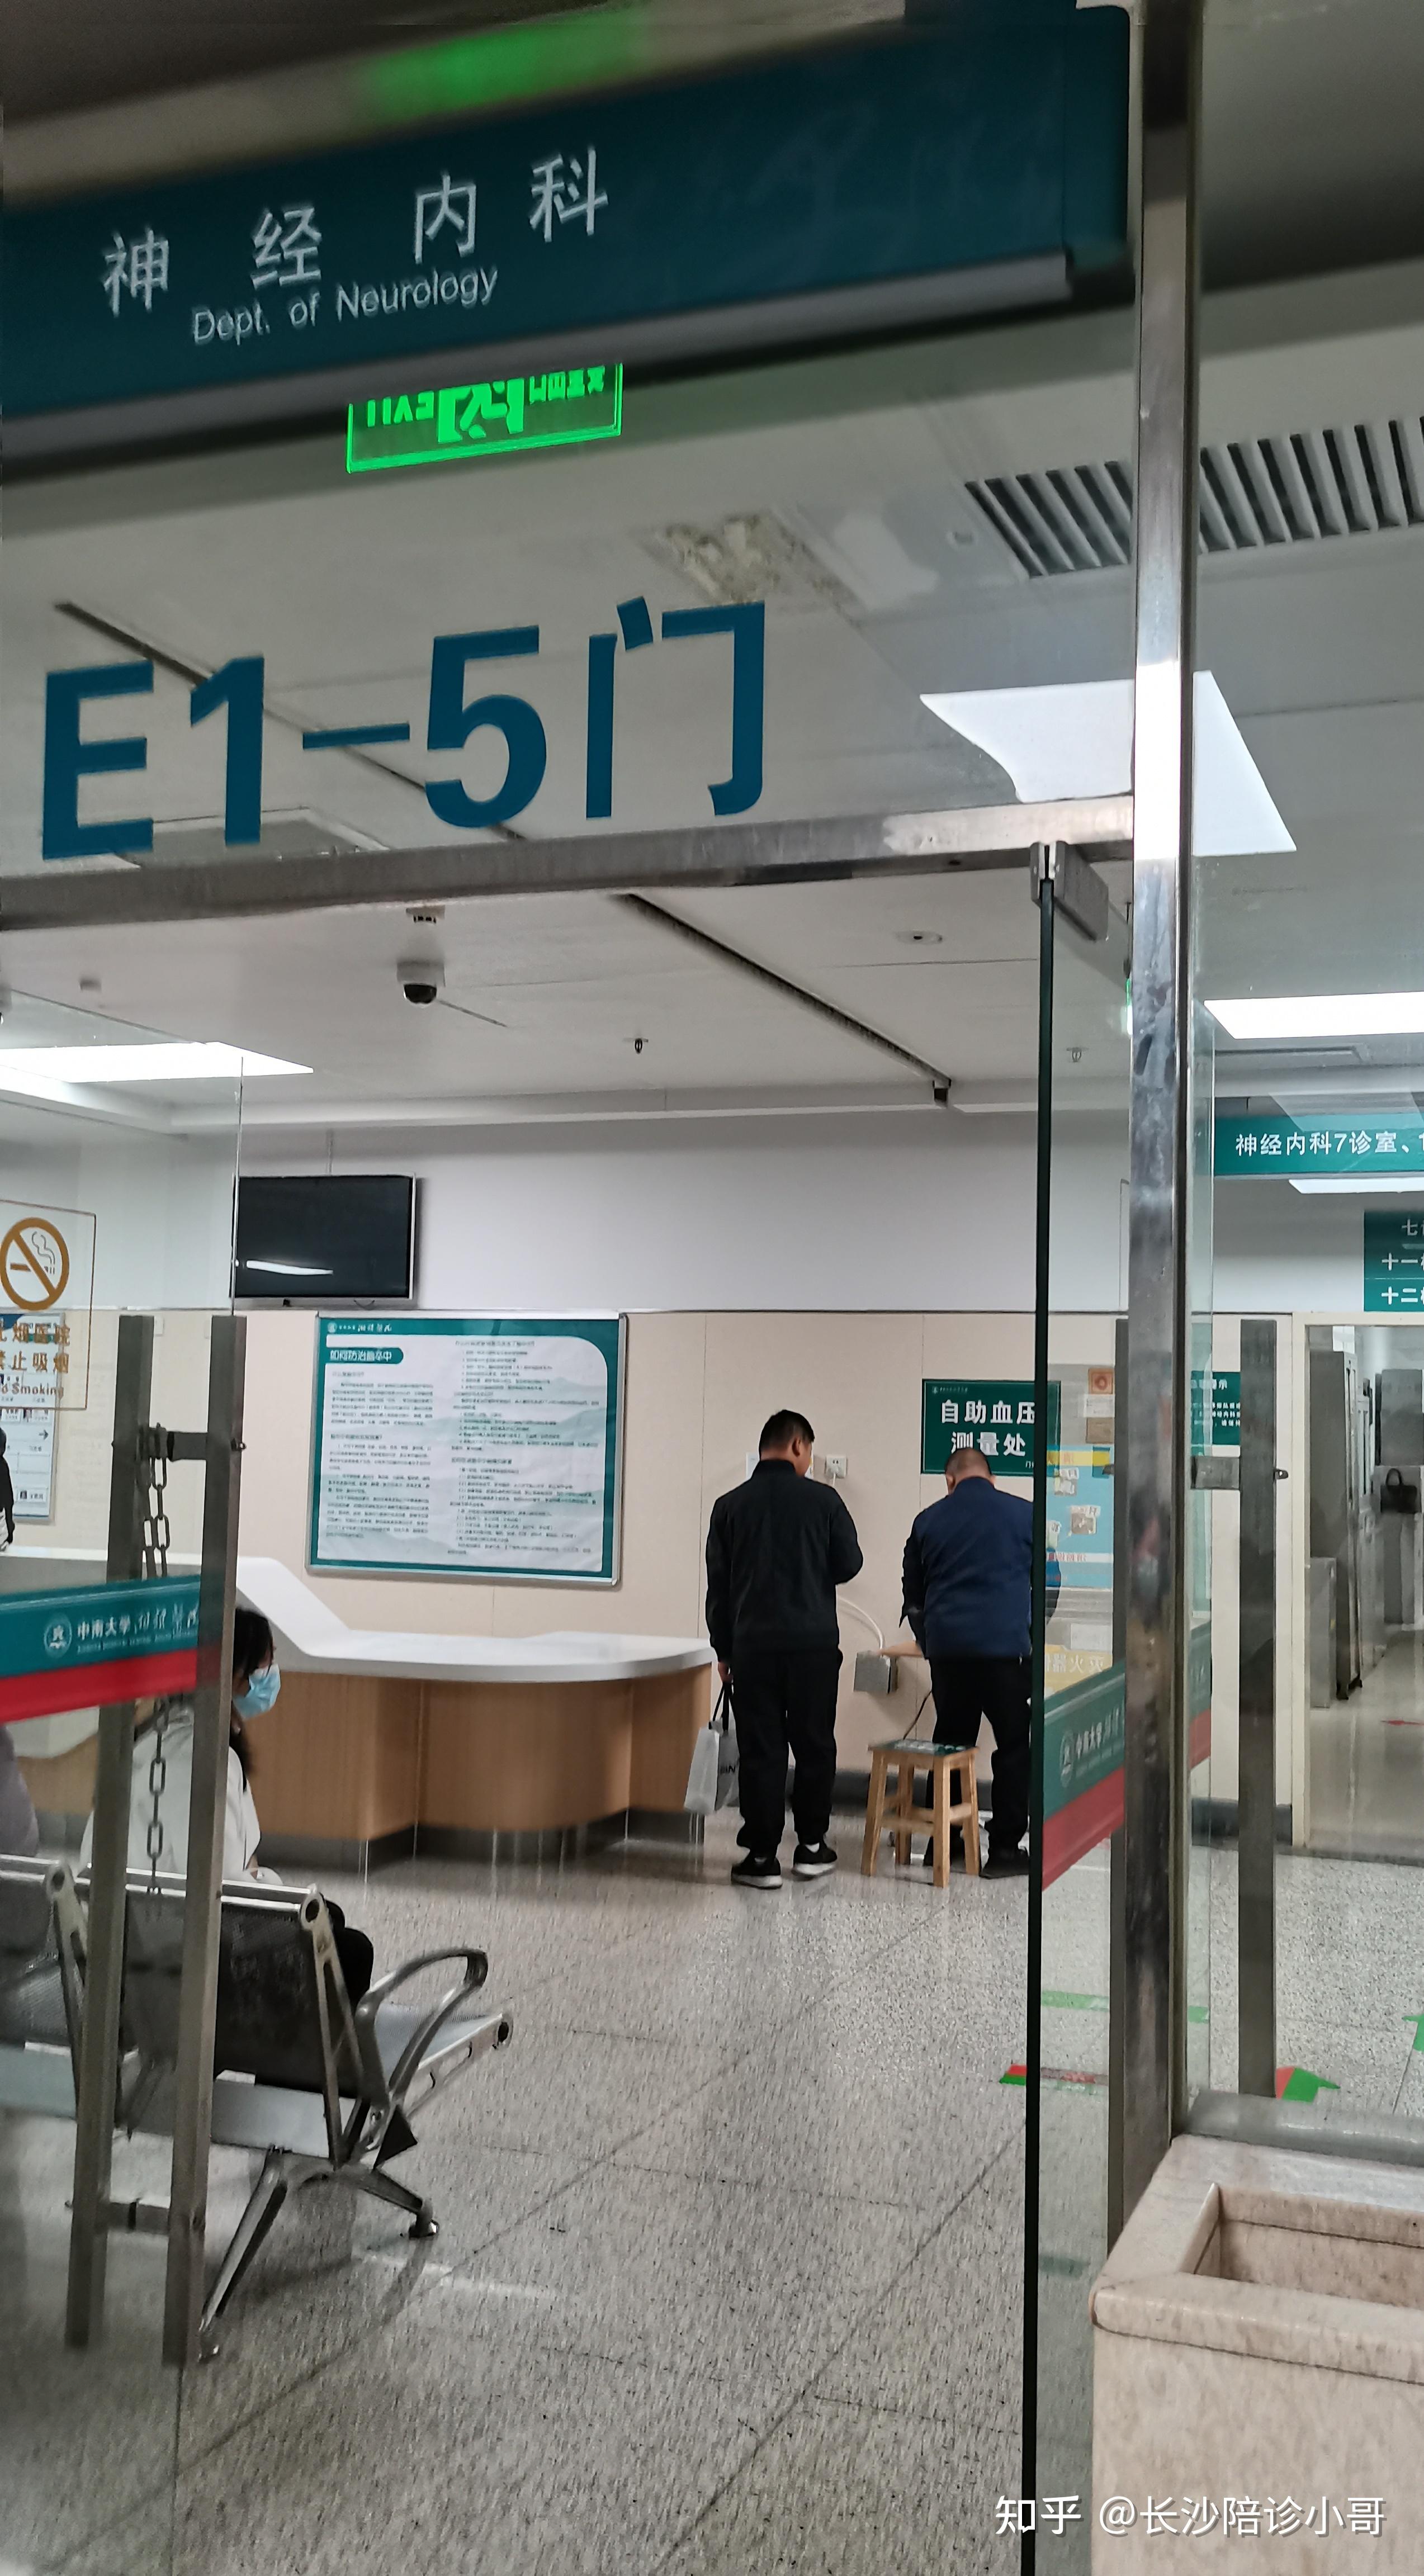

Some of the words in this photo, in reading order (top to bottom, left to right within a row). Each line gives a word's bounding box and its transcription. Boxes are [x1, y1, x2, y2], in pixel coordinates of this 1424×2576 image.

[104, 144, 608, 318] 神经内科
[192, 302, 271, 345] Dept.
[288, 288, 321, 328] of
[336, 266, 498, 323] Neurology
[1401, 1219, 1424, 1236] 七
[1382, 1252, 1424, 1271] 十一
[1381, 1286, 1424, 1305] 十二
[941, 1399, 1034, 1424] 自助血压
[951, 1431, 1026, 1457] 测量处
